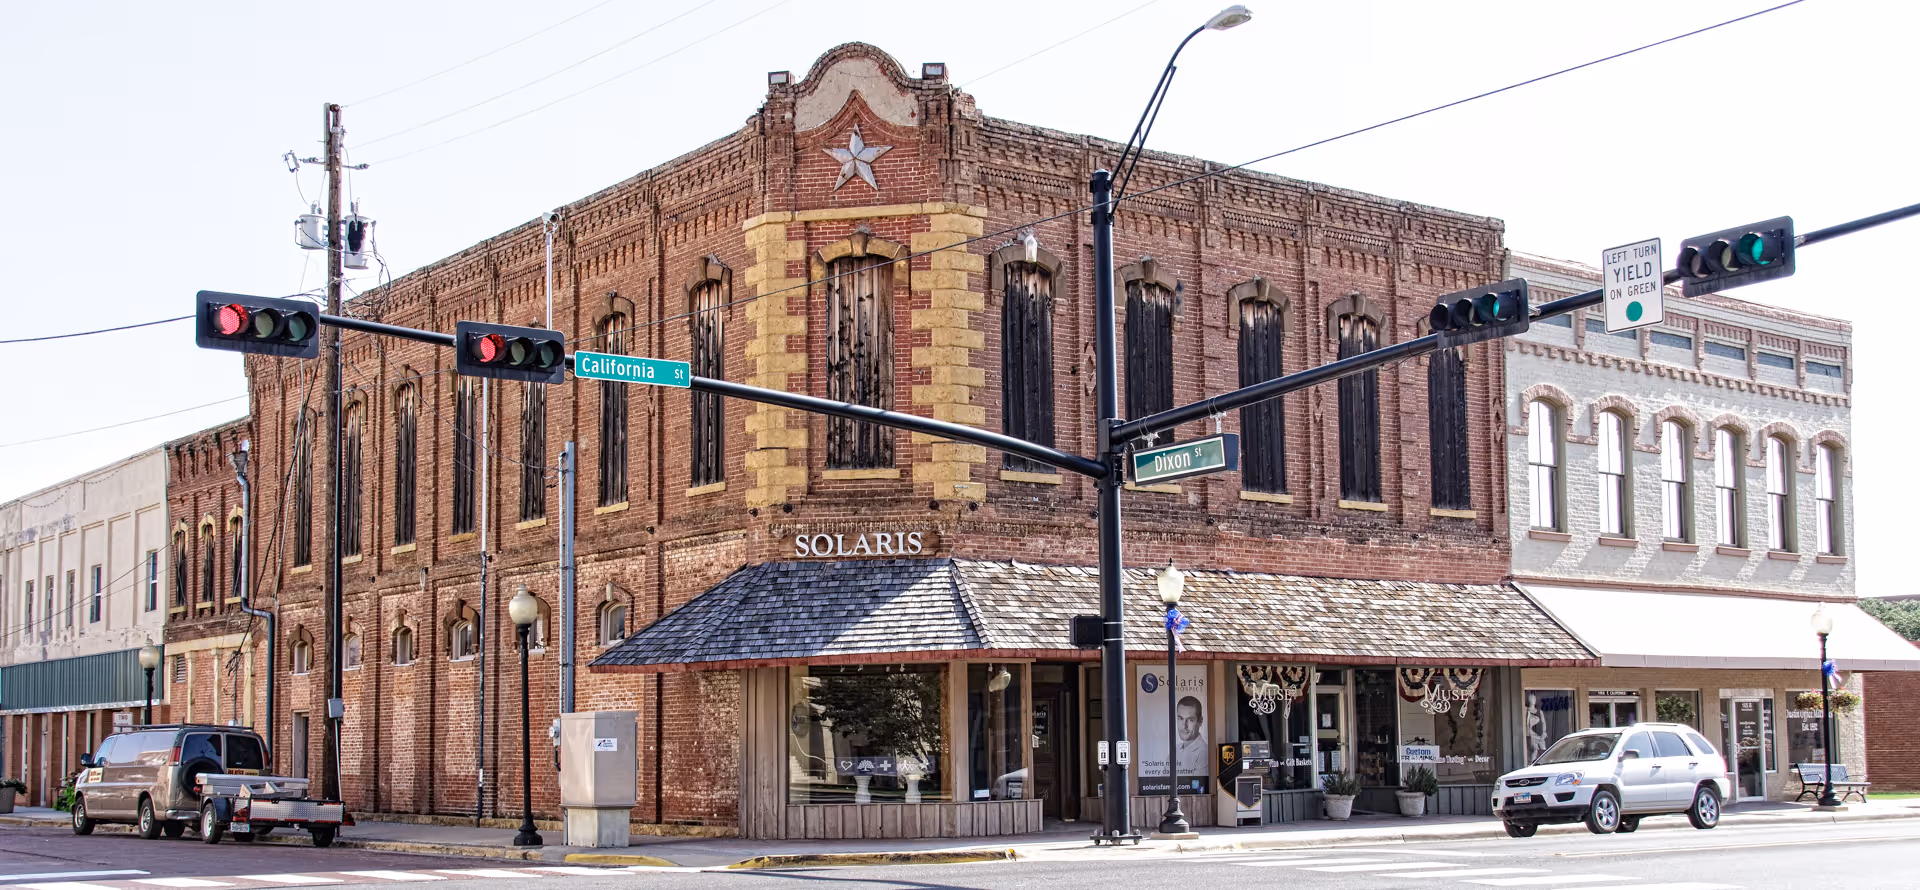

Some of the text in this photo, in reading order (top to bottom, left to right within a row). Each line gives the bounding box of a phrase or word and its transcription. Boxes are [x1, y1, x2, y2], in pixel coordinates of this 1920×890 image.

[1607, 244, 1657, 264] LEFT TURN
[1613, 261, 1652, 284] YIELD
[1610, 281, 1656, 300] ON GREEN
[582, 357, 684, 380] California St
[1154, 447, 1202, 473] Dixon St
[795, 532, 923, 557] SOLARIS
[1296, 758, 1312, 766] Baskets
[1475, 755, 1489, 763] Decor
